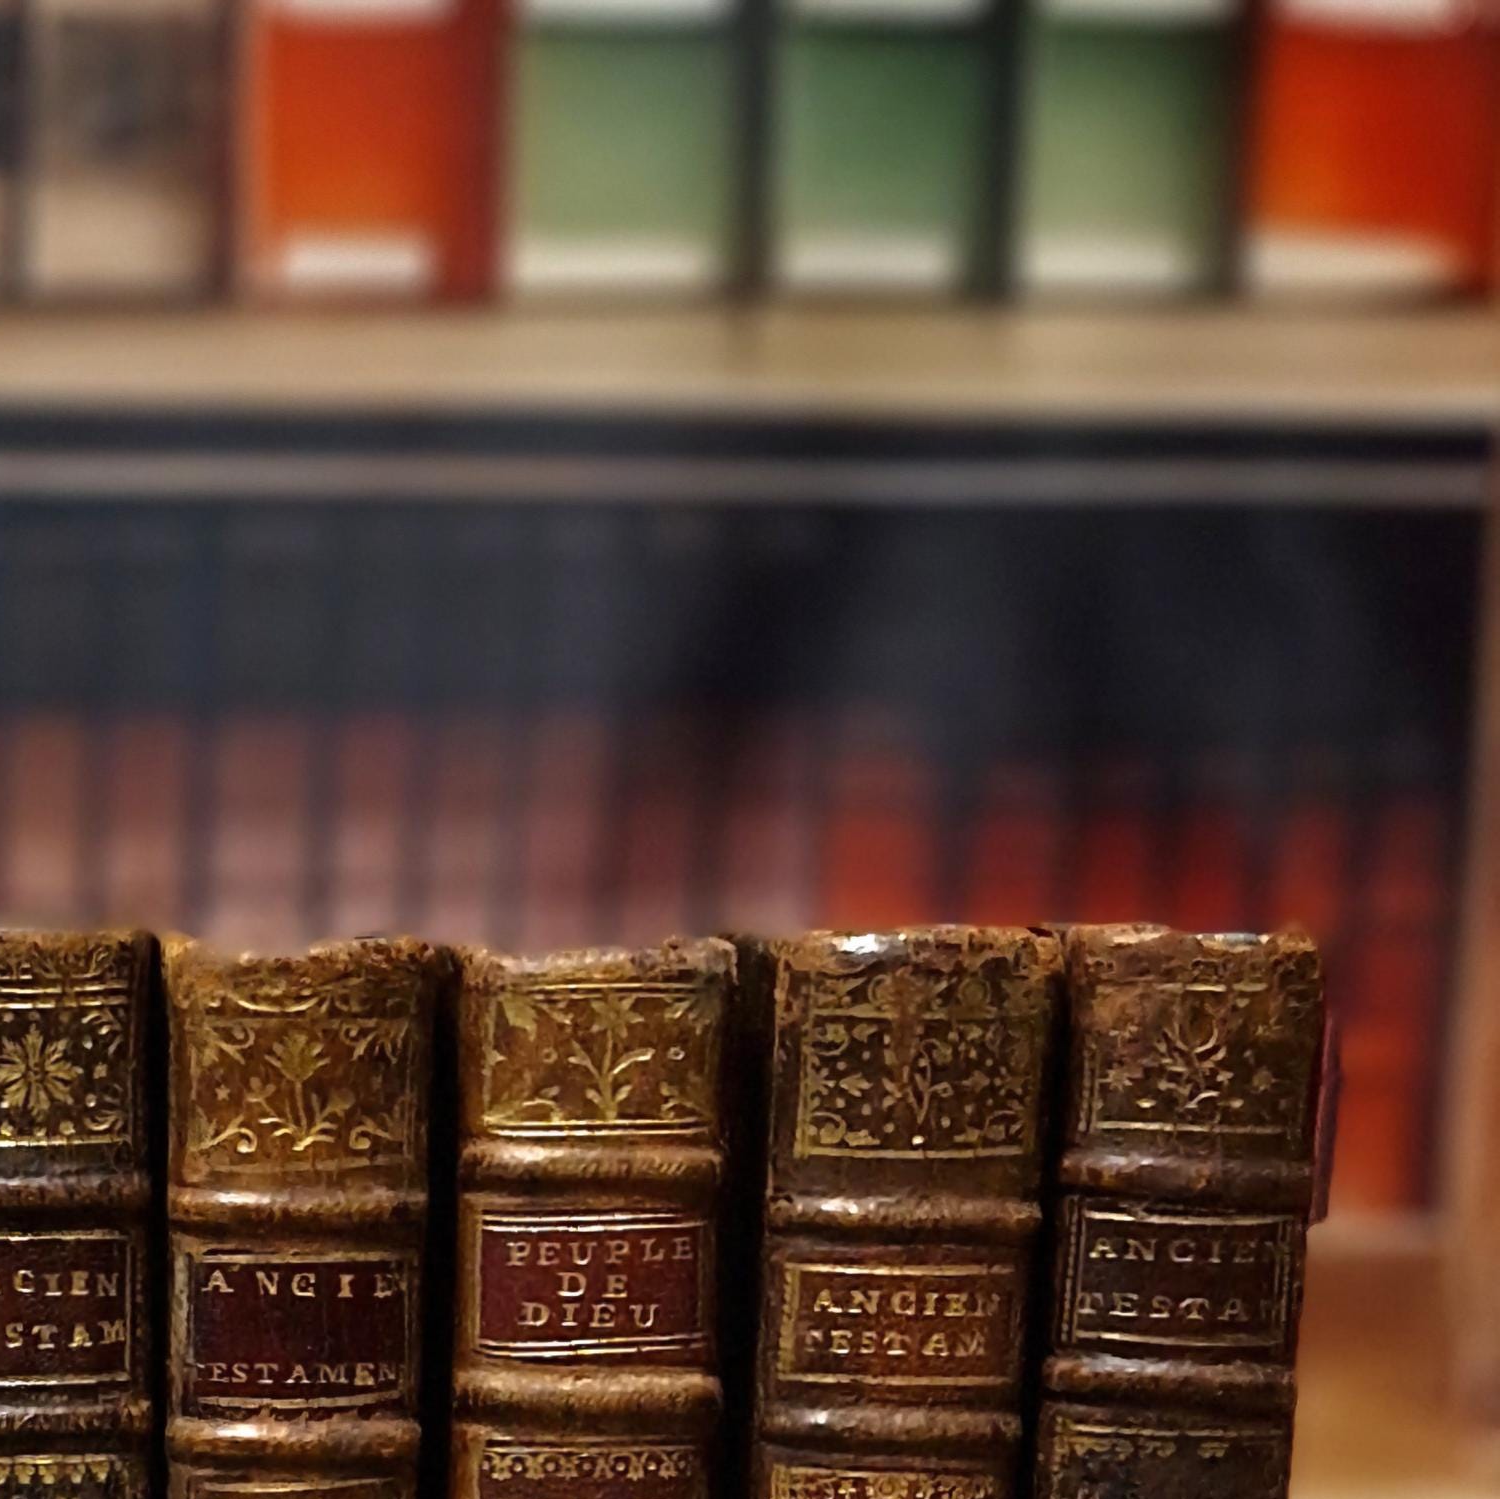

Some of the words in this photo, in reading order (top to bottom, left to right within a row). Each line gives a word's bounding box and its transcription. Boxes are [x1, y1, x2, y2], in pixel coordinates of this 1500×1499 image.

[505, 1236, 695, 1267] PEUPLE
[557, 1271, 630, 1299] DE
[517, 1302, 660, 1329] DIEU
[813, 1288, 1001, 1317] ANCIEN
[194, 1361, 397, 1386] ESTAMEN
